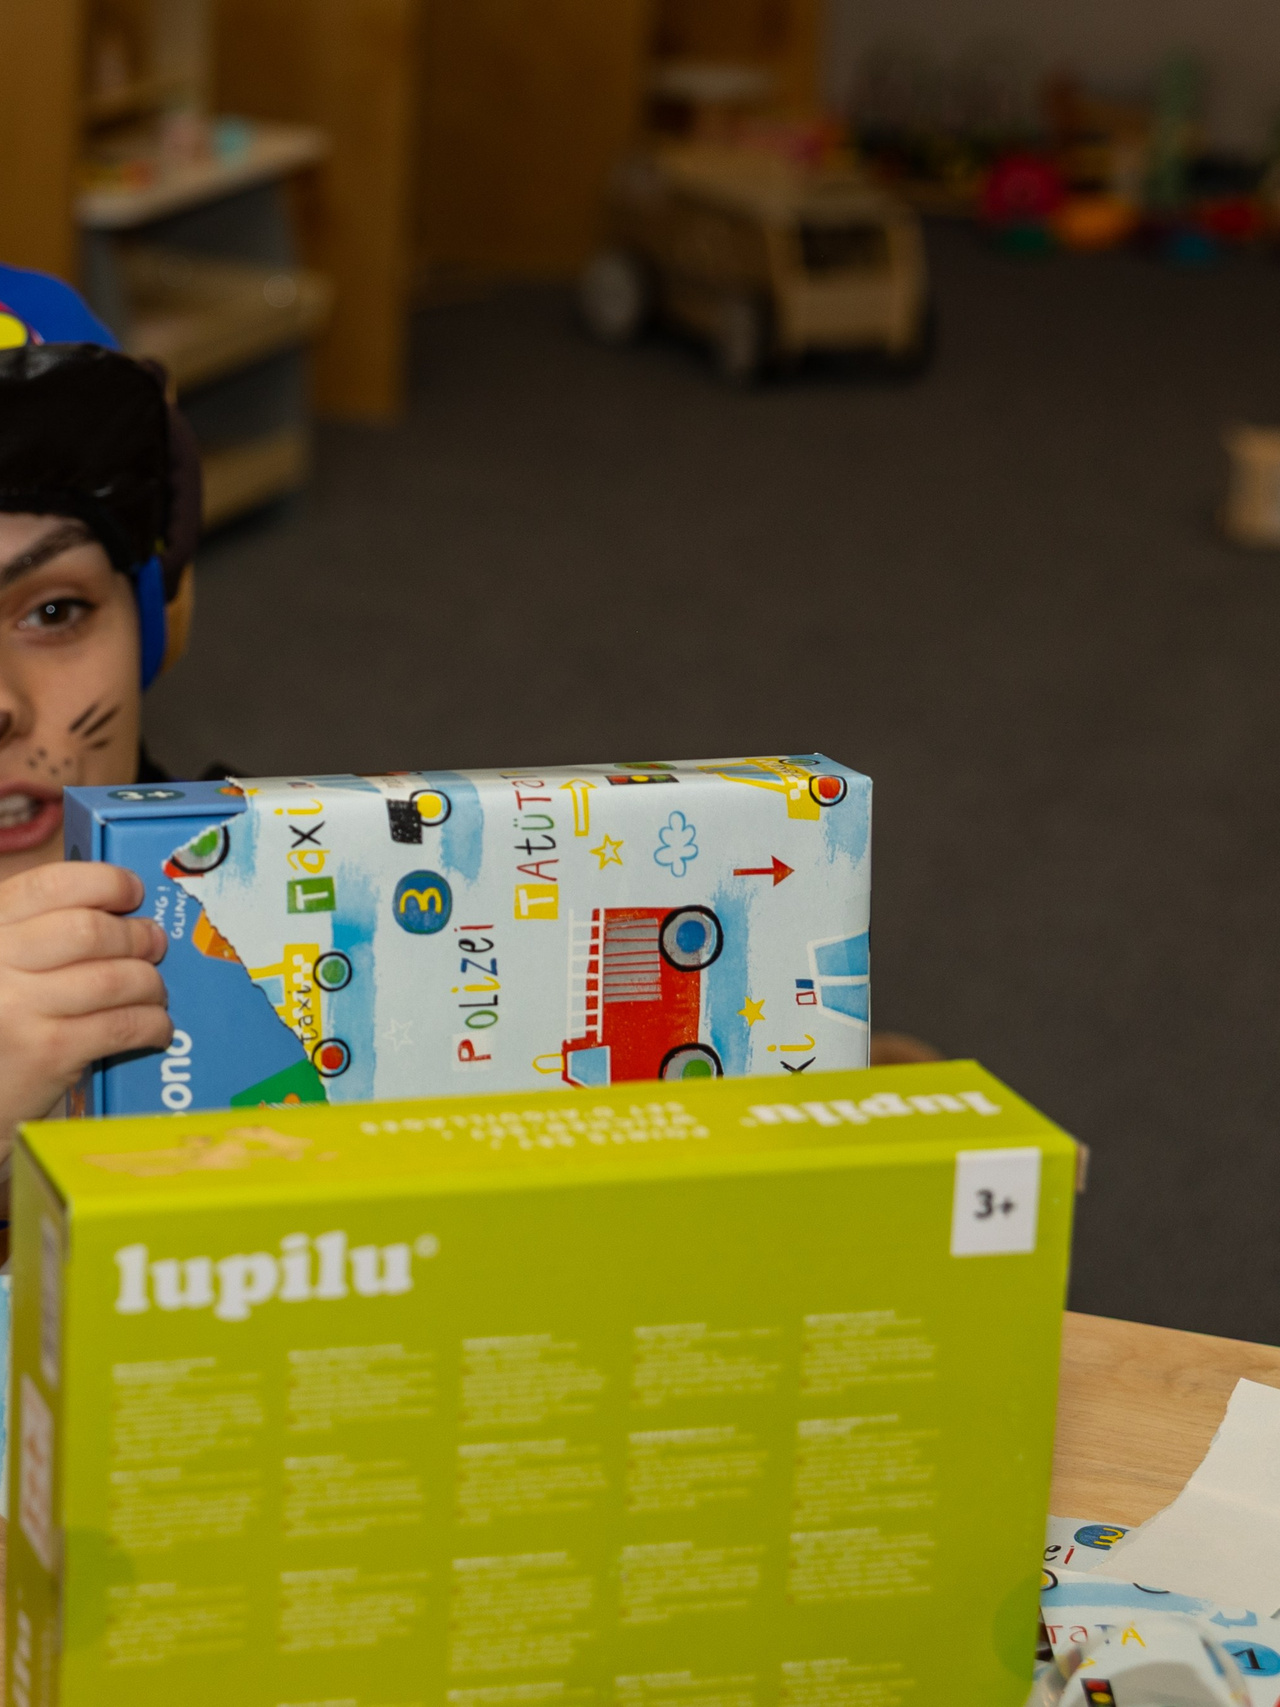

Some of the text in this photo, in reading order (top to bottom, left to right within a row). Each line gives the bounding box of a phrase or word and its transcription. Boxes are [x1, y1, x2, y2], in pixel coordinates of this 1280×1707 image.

[399, 887, 443, 914] 3
[975, 1189, 1016, 1220] 3+
[114, 1230, 414, 1322] lupilu
[1232, 1648, 1266, 1670] 1
